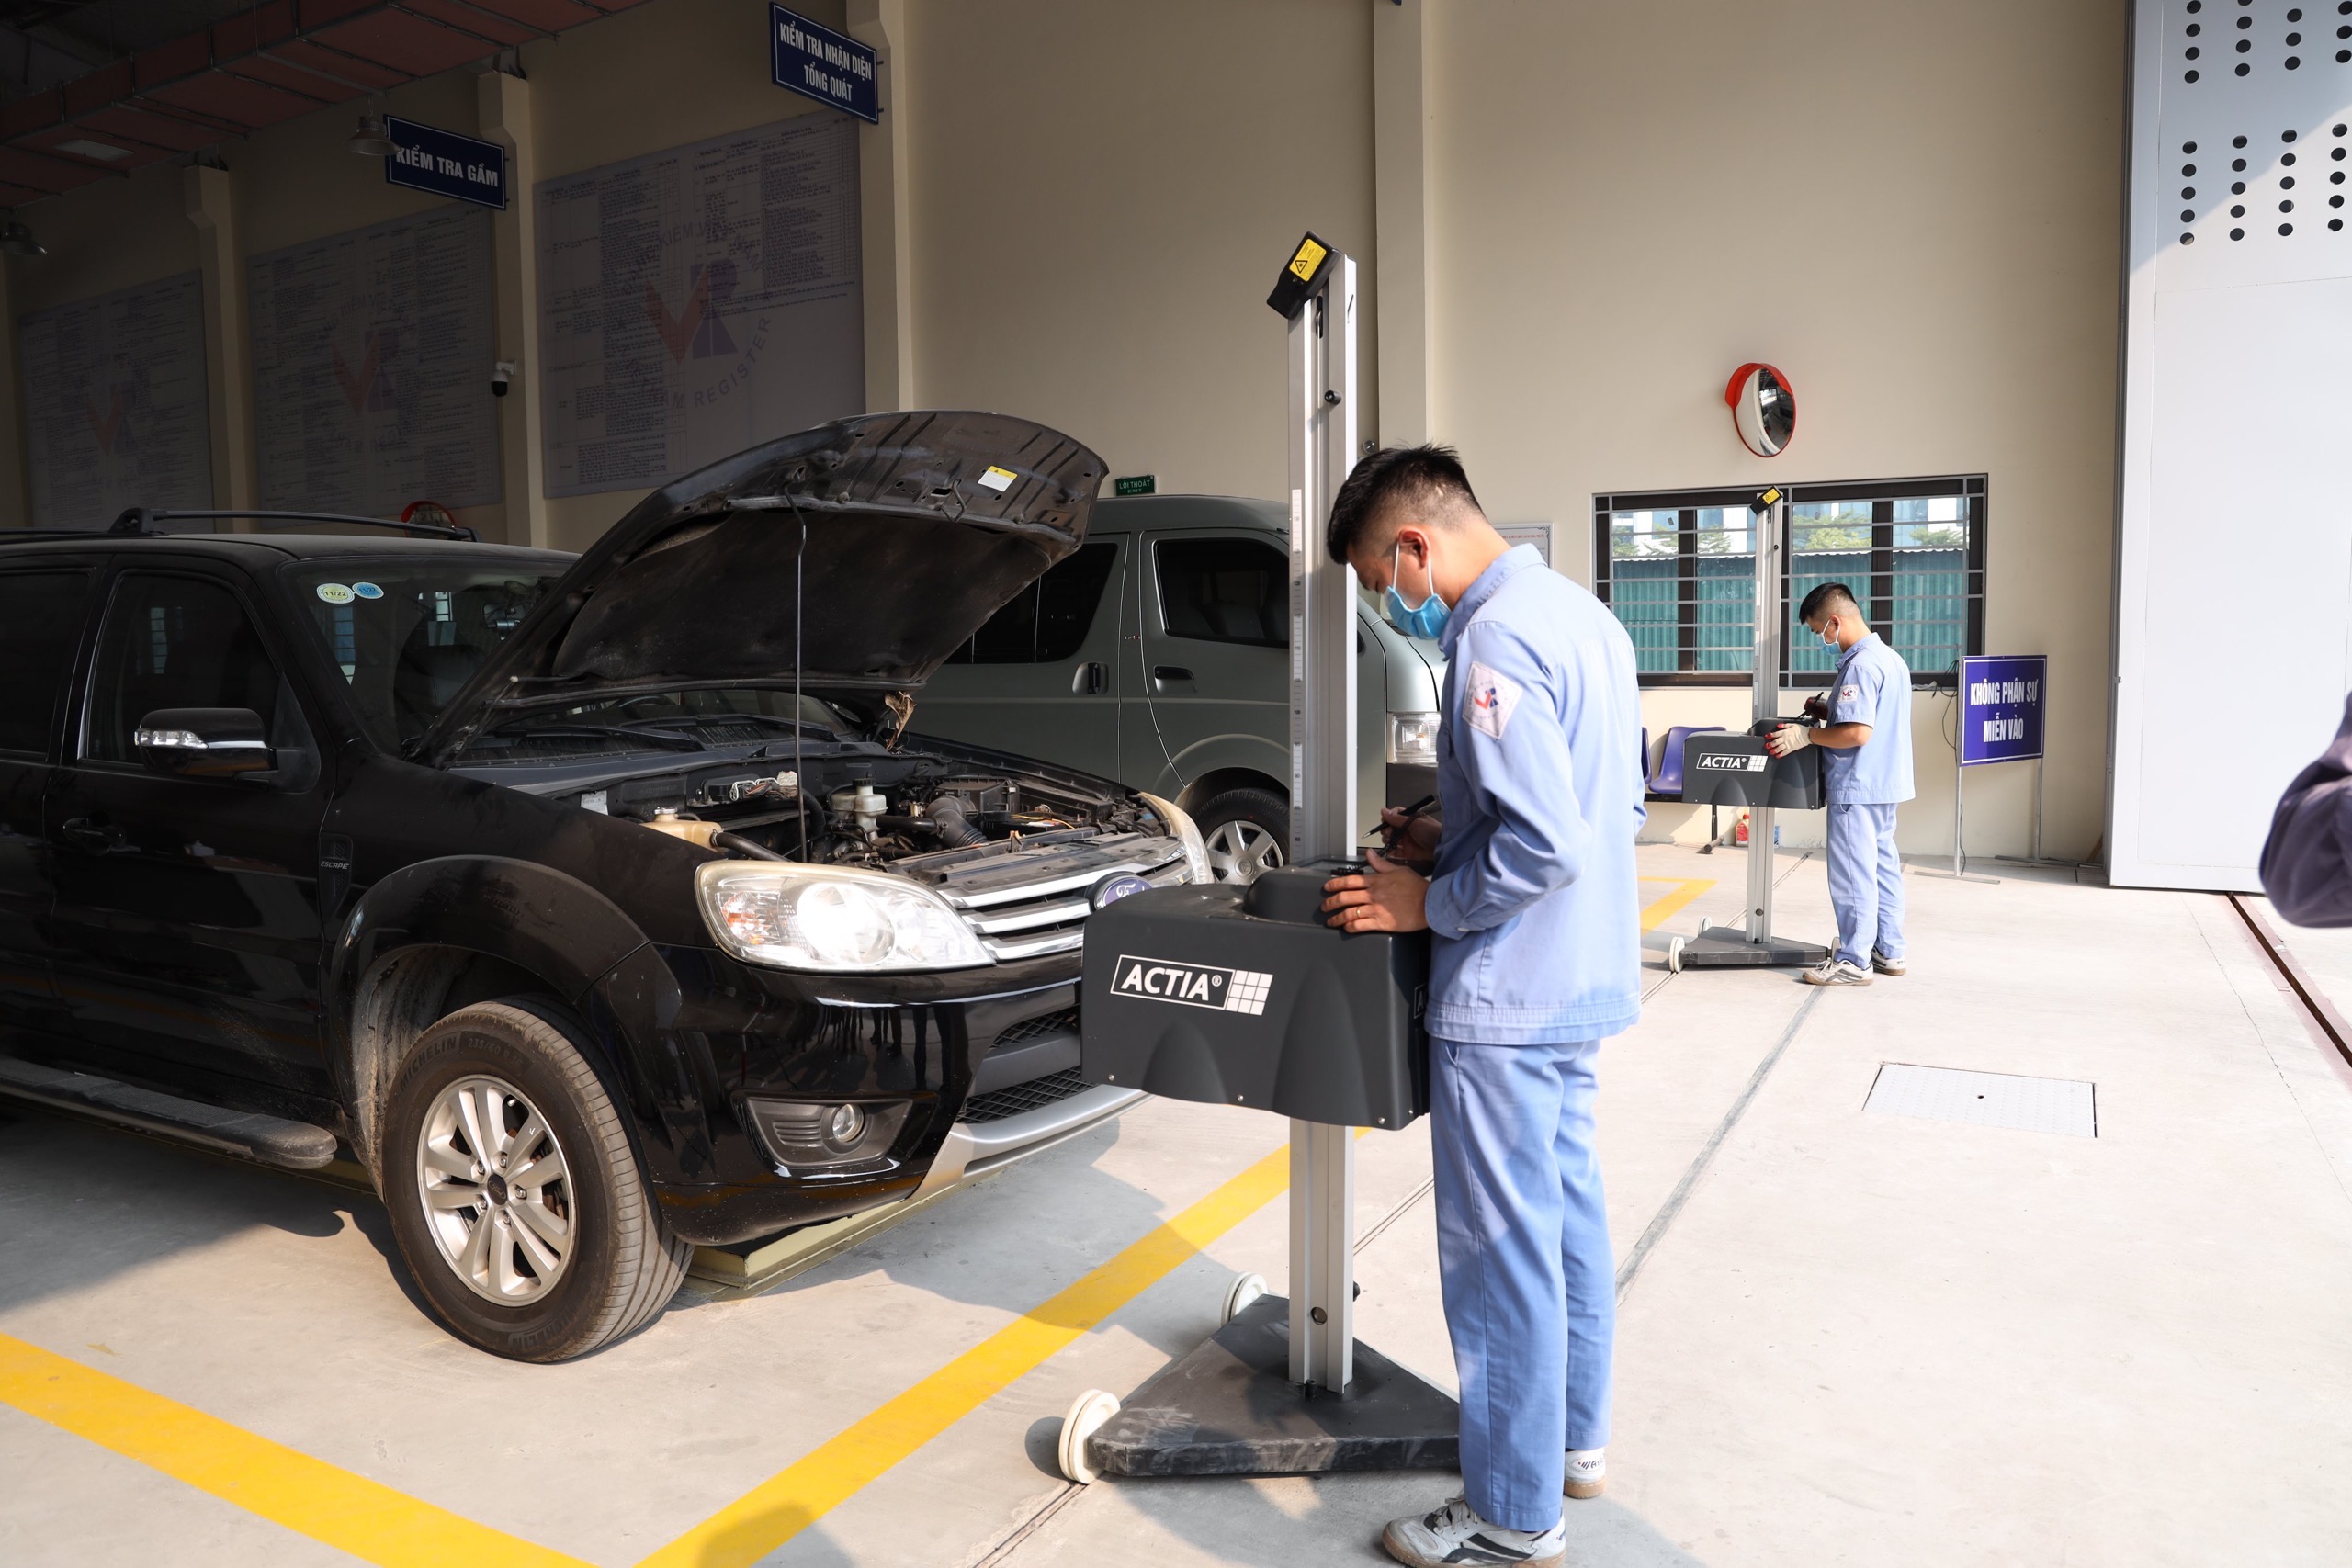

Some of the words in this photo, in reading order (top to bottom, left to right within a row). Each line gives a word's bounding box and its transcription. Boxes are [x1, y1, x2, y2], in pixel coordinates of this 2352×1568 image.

[780, 20, 804, 51] KIỂM
[806, 34, 823, 60] TRA
[825, 42, 850, 72] NHẬN
[852, 55, 872, 81] DIỆN
[804, 61, 828, 93] TỔNG
[830, 77, 853, 102] QUÁT
[396, 144, 434, 171] KIỂM
[436, 156, 464, 179] TRA
[467, 162, 499, 187] GẦM
[694, 315, 771, 408] REGISTER
[1130, 479, 1150, 489] THOÁT
[1970, 678, 2001, 705] KHÔNG
[2002, 677, 2025, 707] PHẬN
[2026, 678, 2040, 706] SỰ
[1983, 712, 2007, 742] MIỄN
[2007, 714, 2024, 740] VÀO
[321, 861, 350, 870] ESCAPE
[400, 1036, 457, 1091] MICHELIN
[468, 1037, 502, 1055] 235/60
